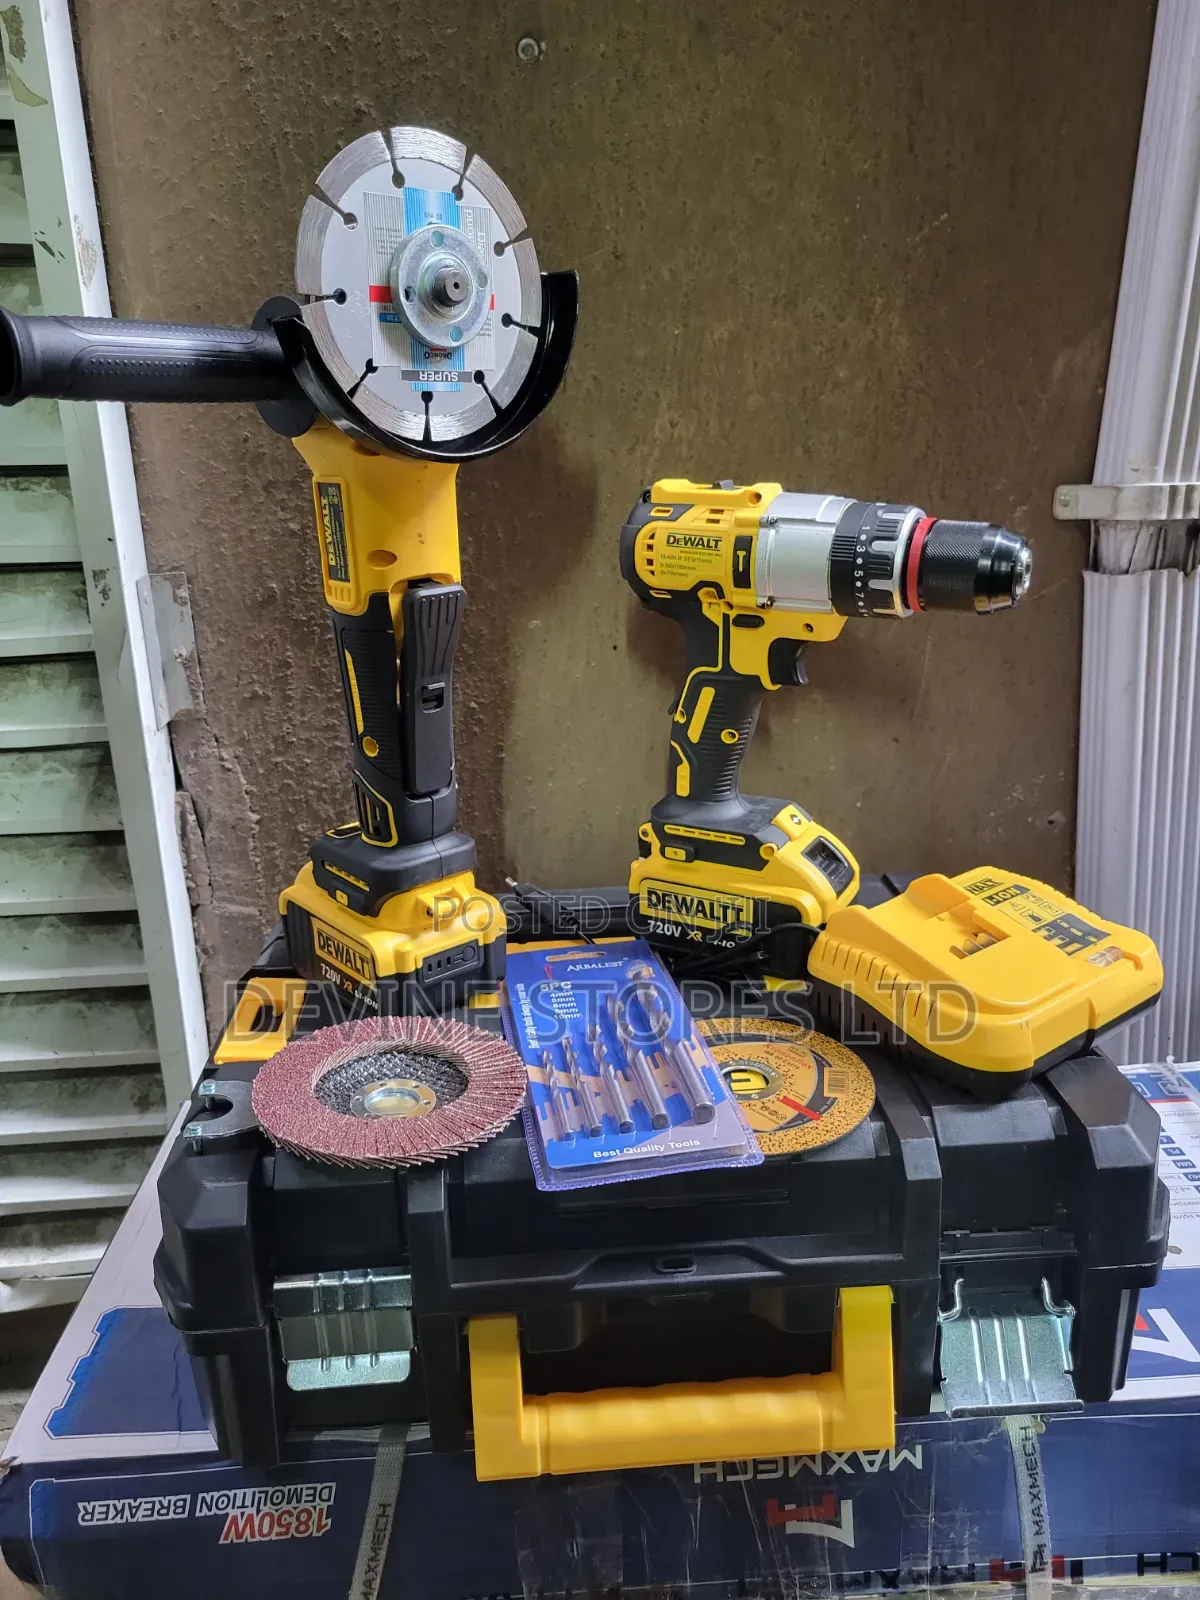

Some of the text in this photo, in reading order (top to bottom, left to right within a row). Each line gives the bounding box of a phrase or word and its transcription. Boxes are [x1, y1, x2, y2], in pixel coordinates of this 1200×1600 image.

[424, 351, 453, 361] DRONCO
[419, 371, 459, 383] SUPER
[666, 534, 722, 549] DEWALT
[856, 545, 866, 553] 3
[648, 920, 682, 938] 720V
[320, 963, 341, 985] 720V
[567, 961, 624, 972] ARBALEST
[540, 981, 572, 991] 5PC
[593, 1139, 701, 1158] Best Quality Tools
[1019, 1425, 1045, 1533] MAXMECH
[77, 1482, 336, 1526] DEMOLITION BREAKER
[218, 1506, 332, 1545] 1850W
